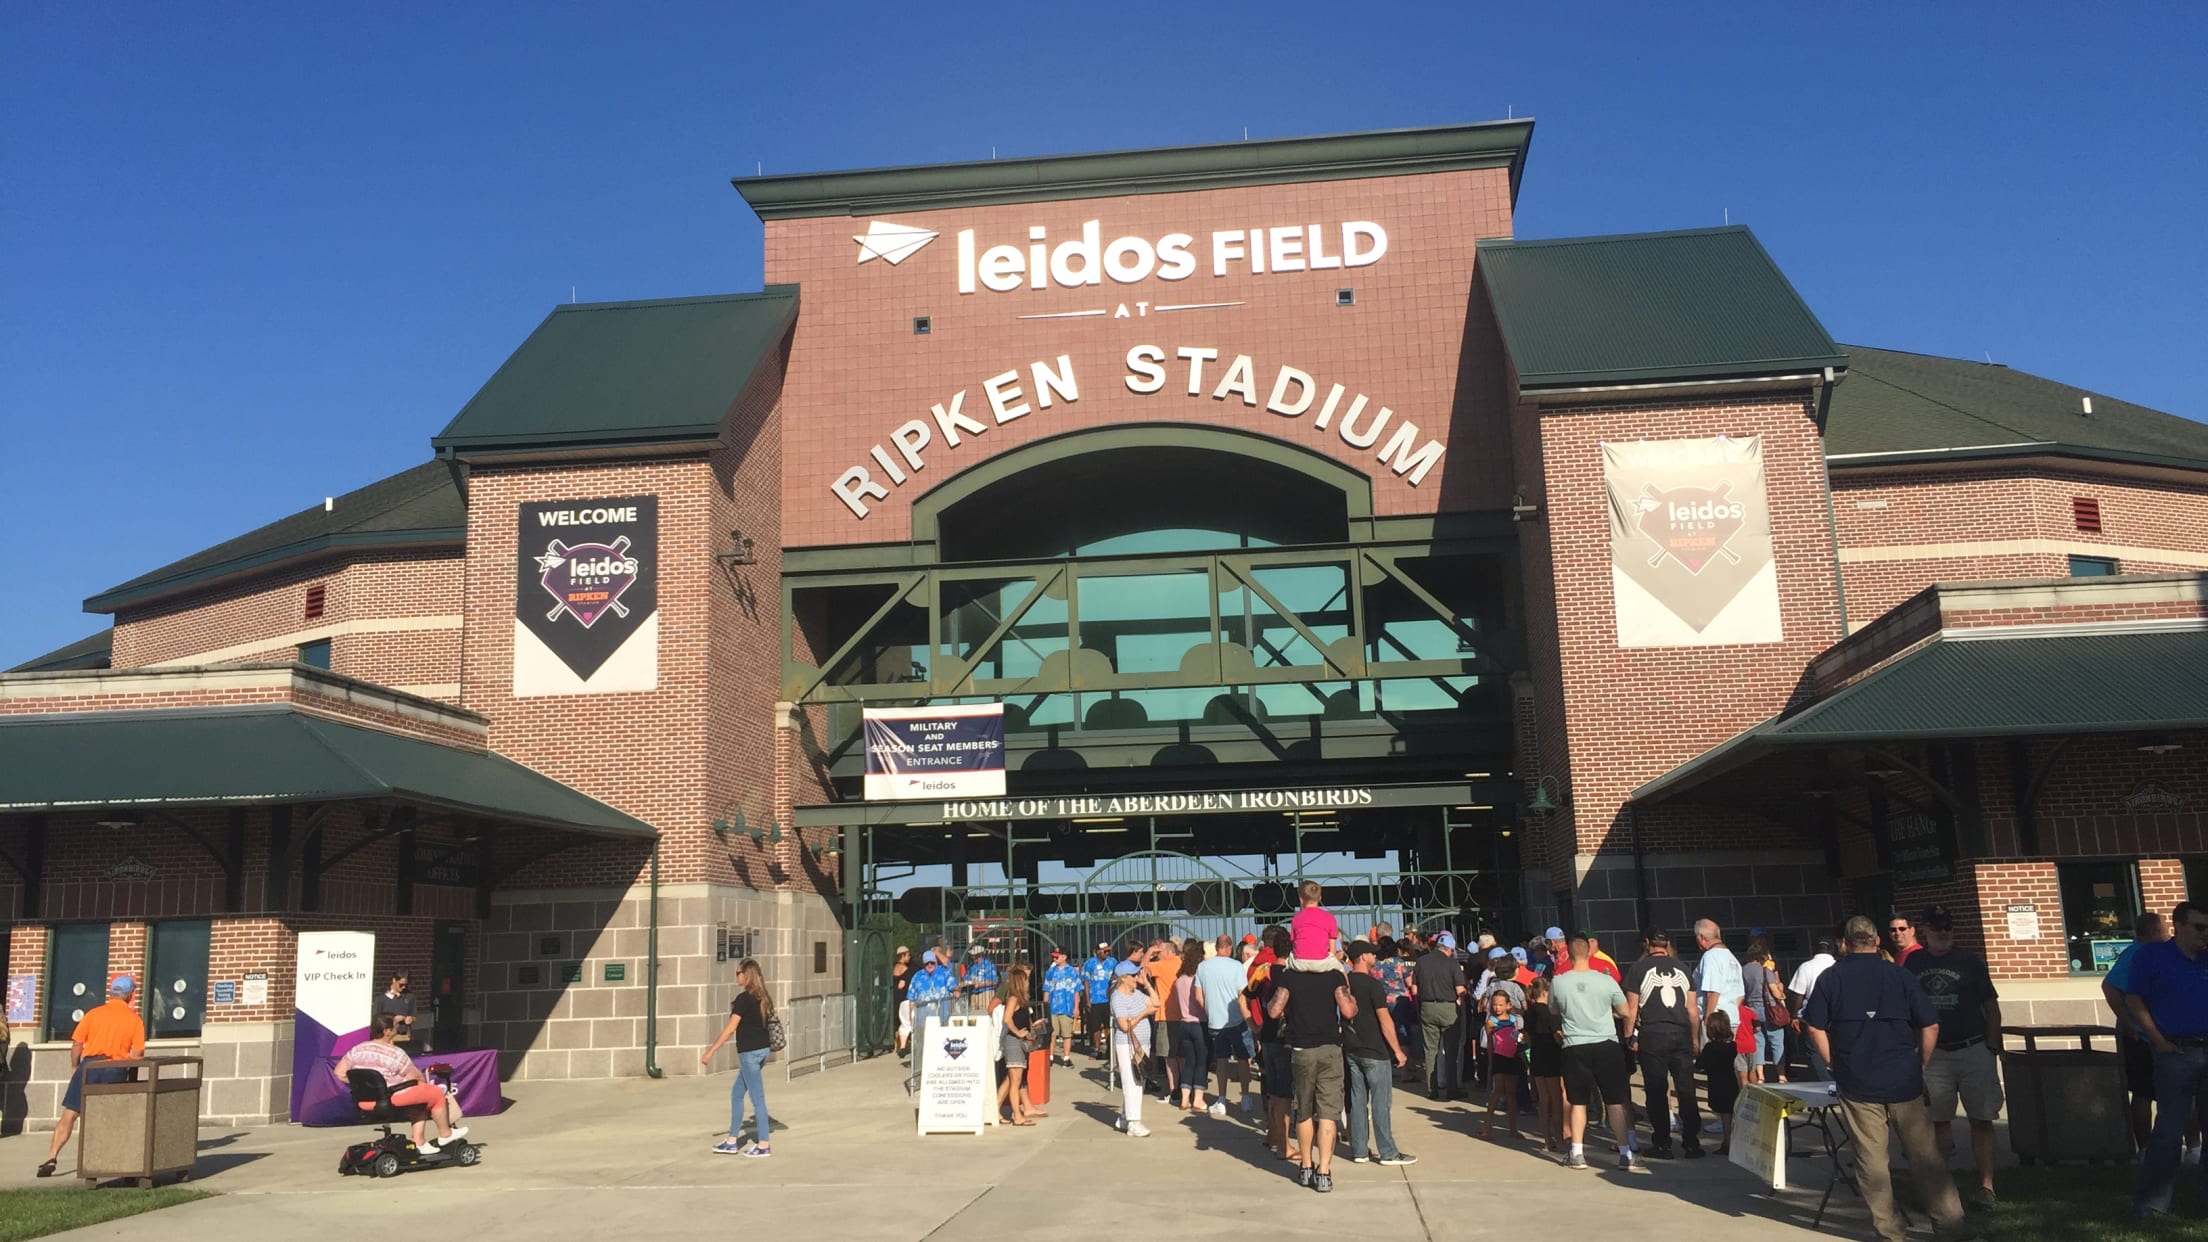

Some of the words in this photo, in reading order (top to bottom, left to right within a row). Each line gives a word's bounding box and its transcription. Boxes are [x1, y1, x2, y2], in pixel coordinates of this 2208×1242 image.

[957, 219, 1197, 294] leidos
[1212, 220, 1389, 277] FIELD
[1114, 302, 1149, 319] AT
[830, 354, 1079, 519] RIPKEN
[1124, 344, 1447, 487] STADIUM
[1669, 500, 1742, 520] leidos
[539, 507, 637, 527] WELCOME
[1670, 521, 1715, 530] FIELD
[570, 556, 635, 577] leidos
[570, 577, 610, 585] FIELD
[910, 722, 958, 732] MILITARY
[918, 742, 943, 752] SEAT
[946, 740, 998, 751] MEMBERS
[906, 756, 962, 767] ENTRANCE
[922, 781, 956, 790] leidos
[943, 799, 1013, 818] HOME
[1018, 799, 1050, 816] OF
[1054, 796, 1102, 815] THE
[1106, 791, 1233, 813] ABERDEEN
[1240, 787, 1373, 809] IRONBIRDS
[328, 950, 357, 959] leidos
[304, 973, 321, 981] VIP
[323, 971, 353, 980] Check
[356, 971, 366, 979] In
